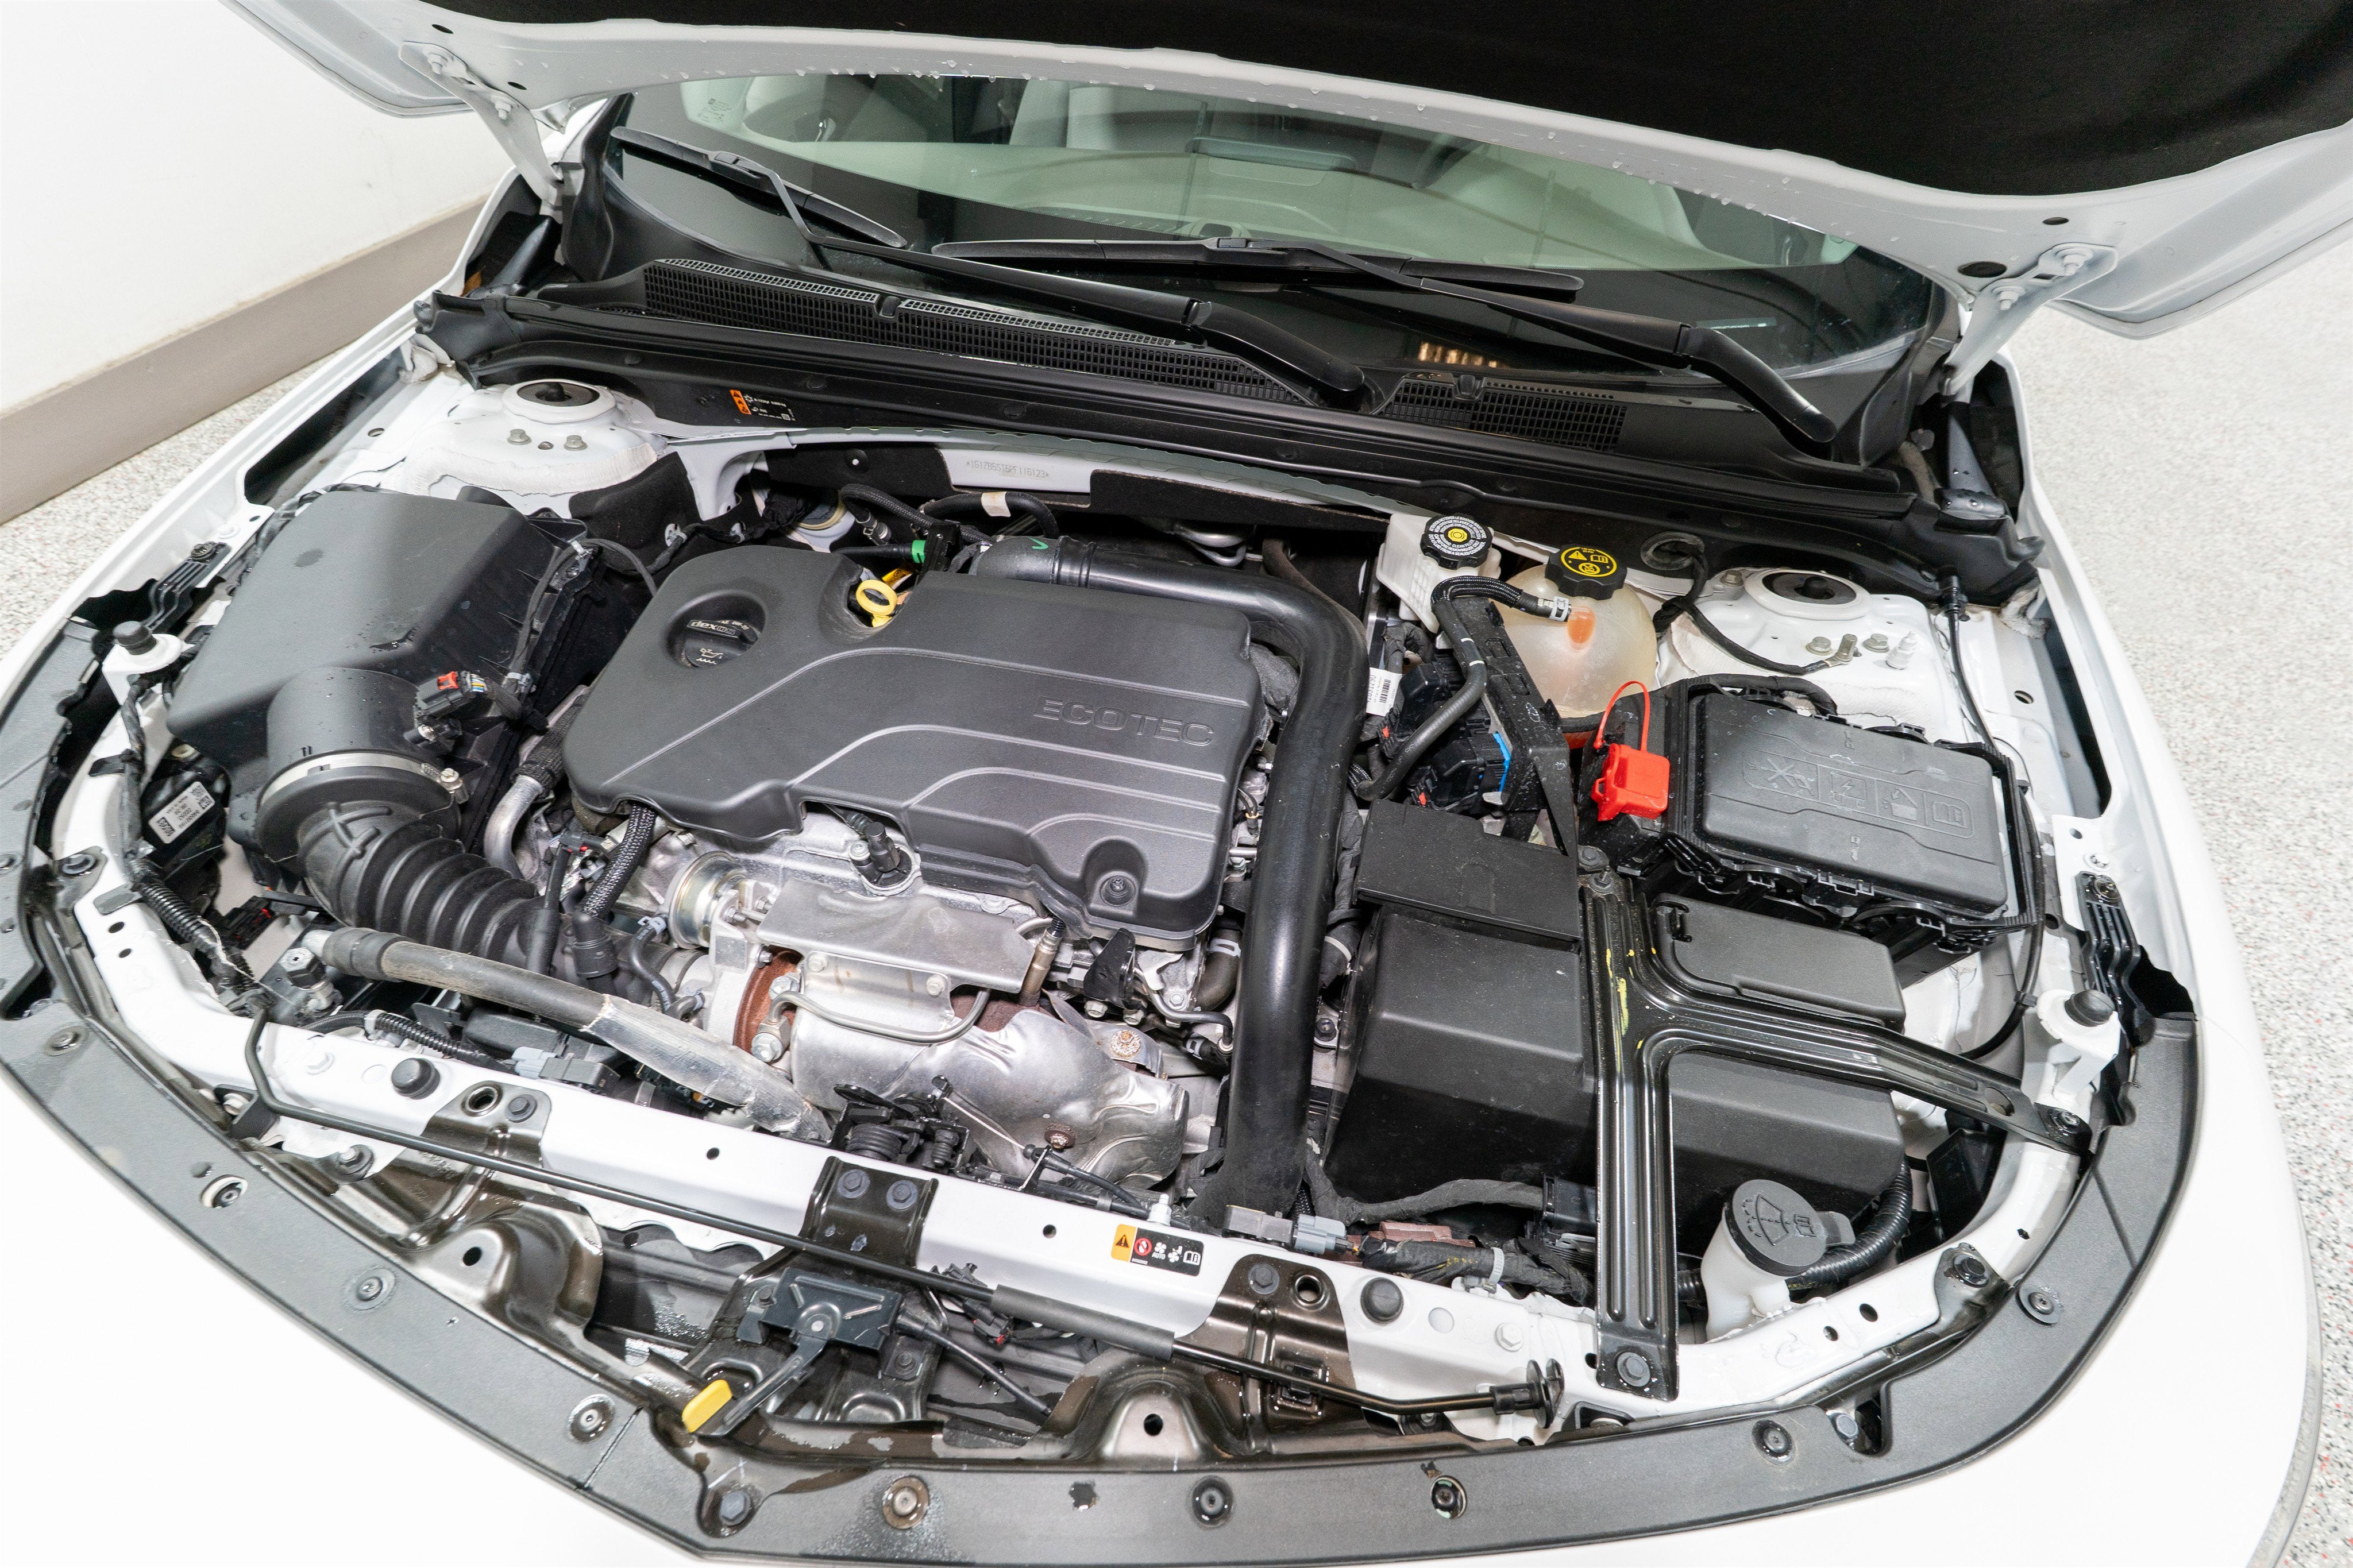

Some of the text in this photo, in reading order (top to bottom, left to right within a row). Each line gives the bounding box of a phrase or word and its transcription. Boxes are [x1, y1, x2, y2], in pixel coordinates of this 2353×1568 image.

[691, 621, 736, 635] dexos
[1033, 696, 1214, 746] ECOTEC
[1151, 1252, 1166, 1260] AUTO
